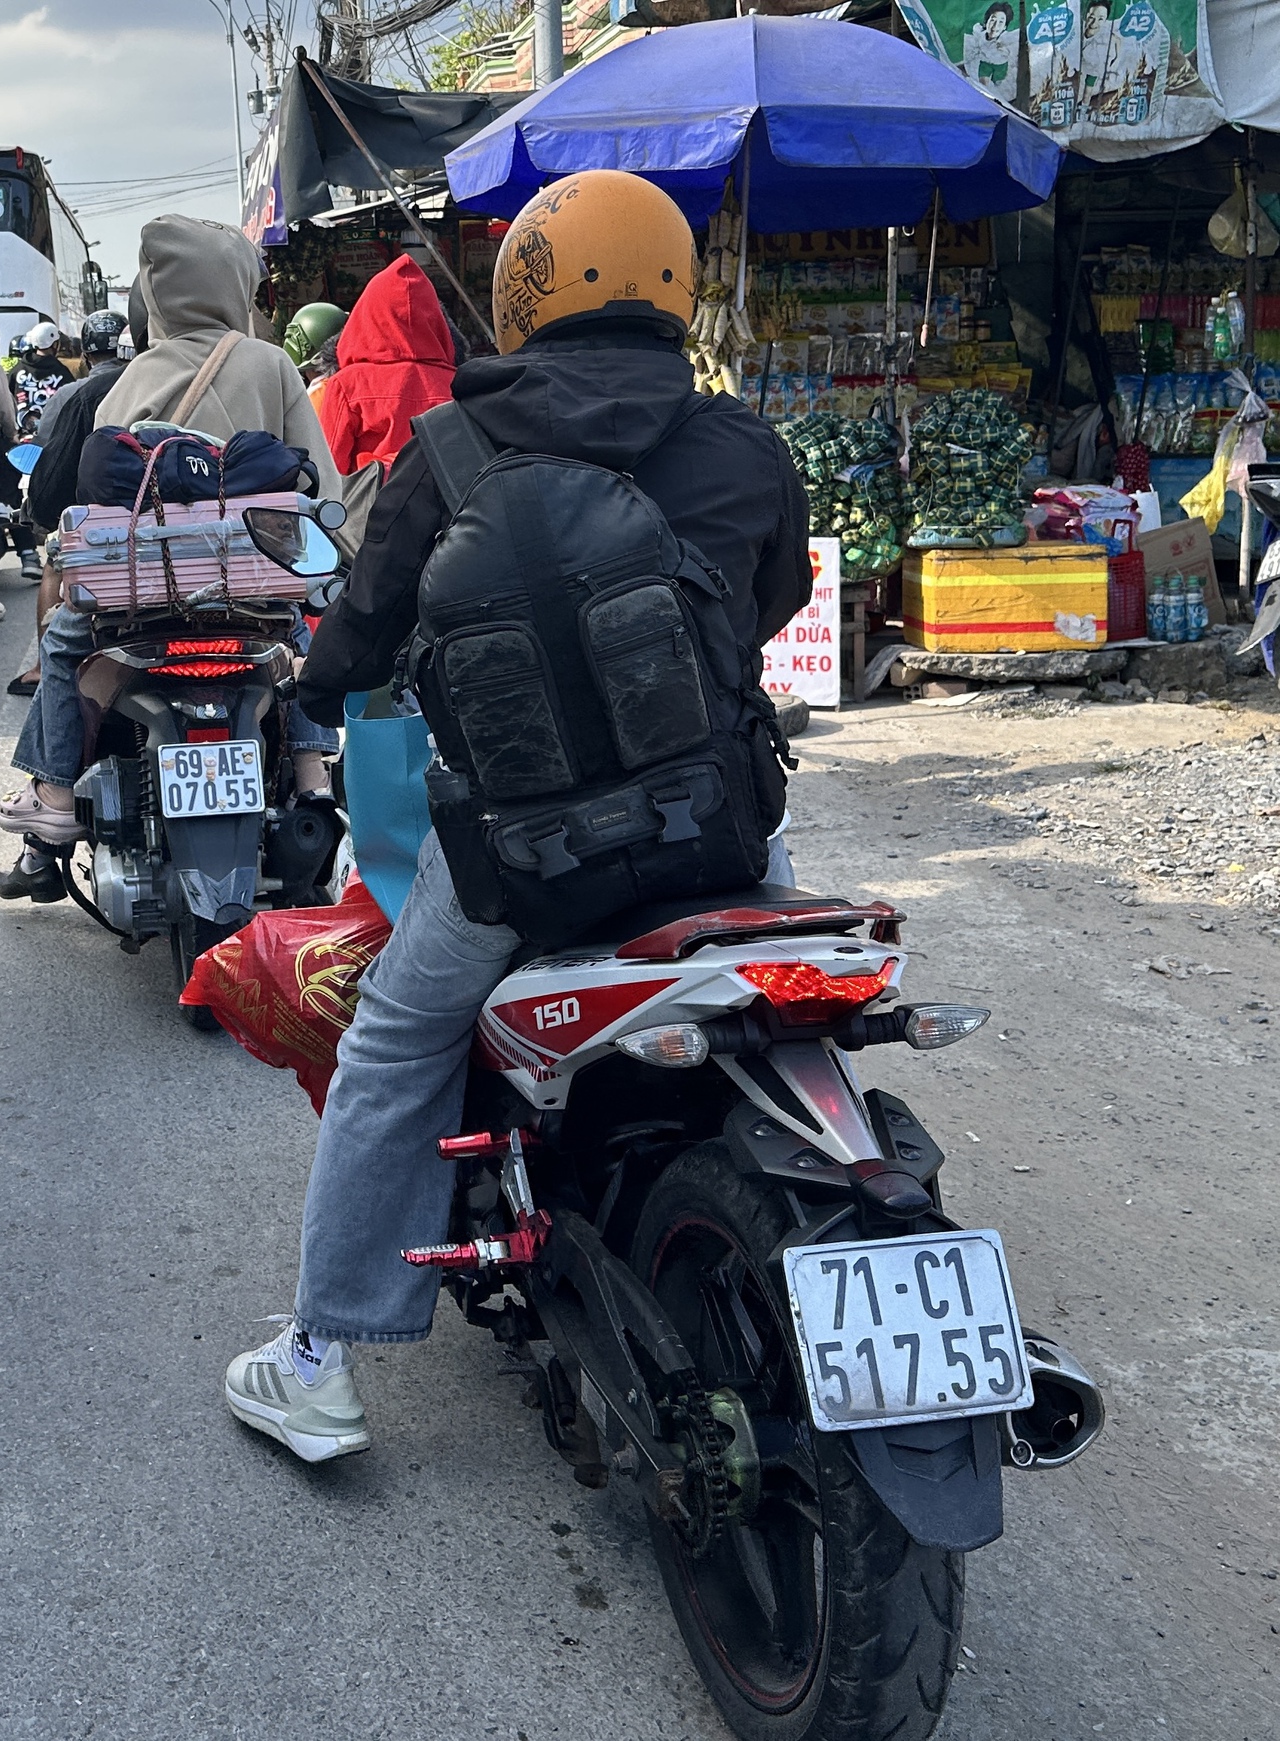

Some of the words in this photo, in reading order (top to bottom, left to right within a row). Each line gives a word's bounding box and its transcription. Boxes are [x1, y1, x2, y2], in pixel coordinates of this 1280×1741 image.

[1034, 20, 1067, 40] A2
[1125, 16, 1151, 32] A2
[815, 587, 834, 602] HỊT
[808, 603, 820, 619] BÌ
[796, 621, 832, 643] DỪA
[763, 655, 772, 671] G
[792, 655, 832, 675] KẸO
[532, 996, 581, 1031] 150
[820, 1247, 974, 1331] 71-C1
[815, 1323, 1015, 1411] 517.55
